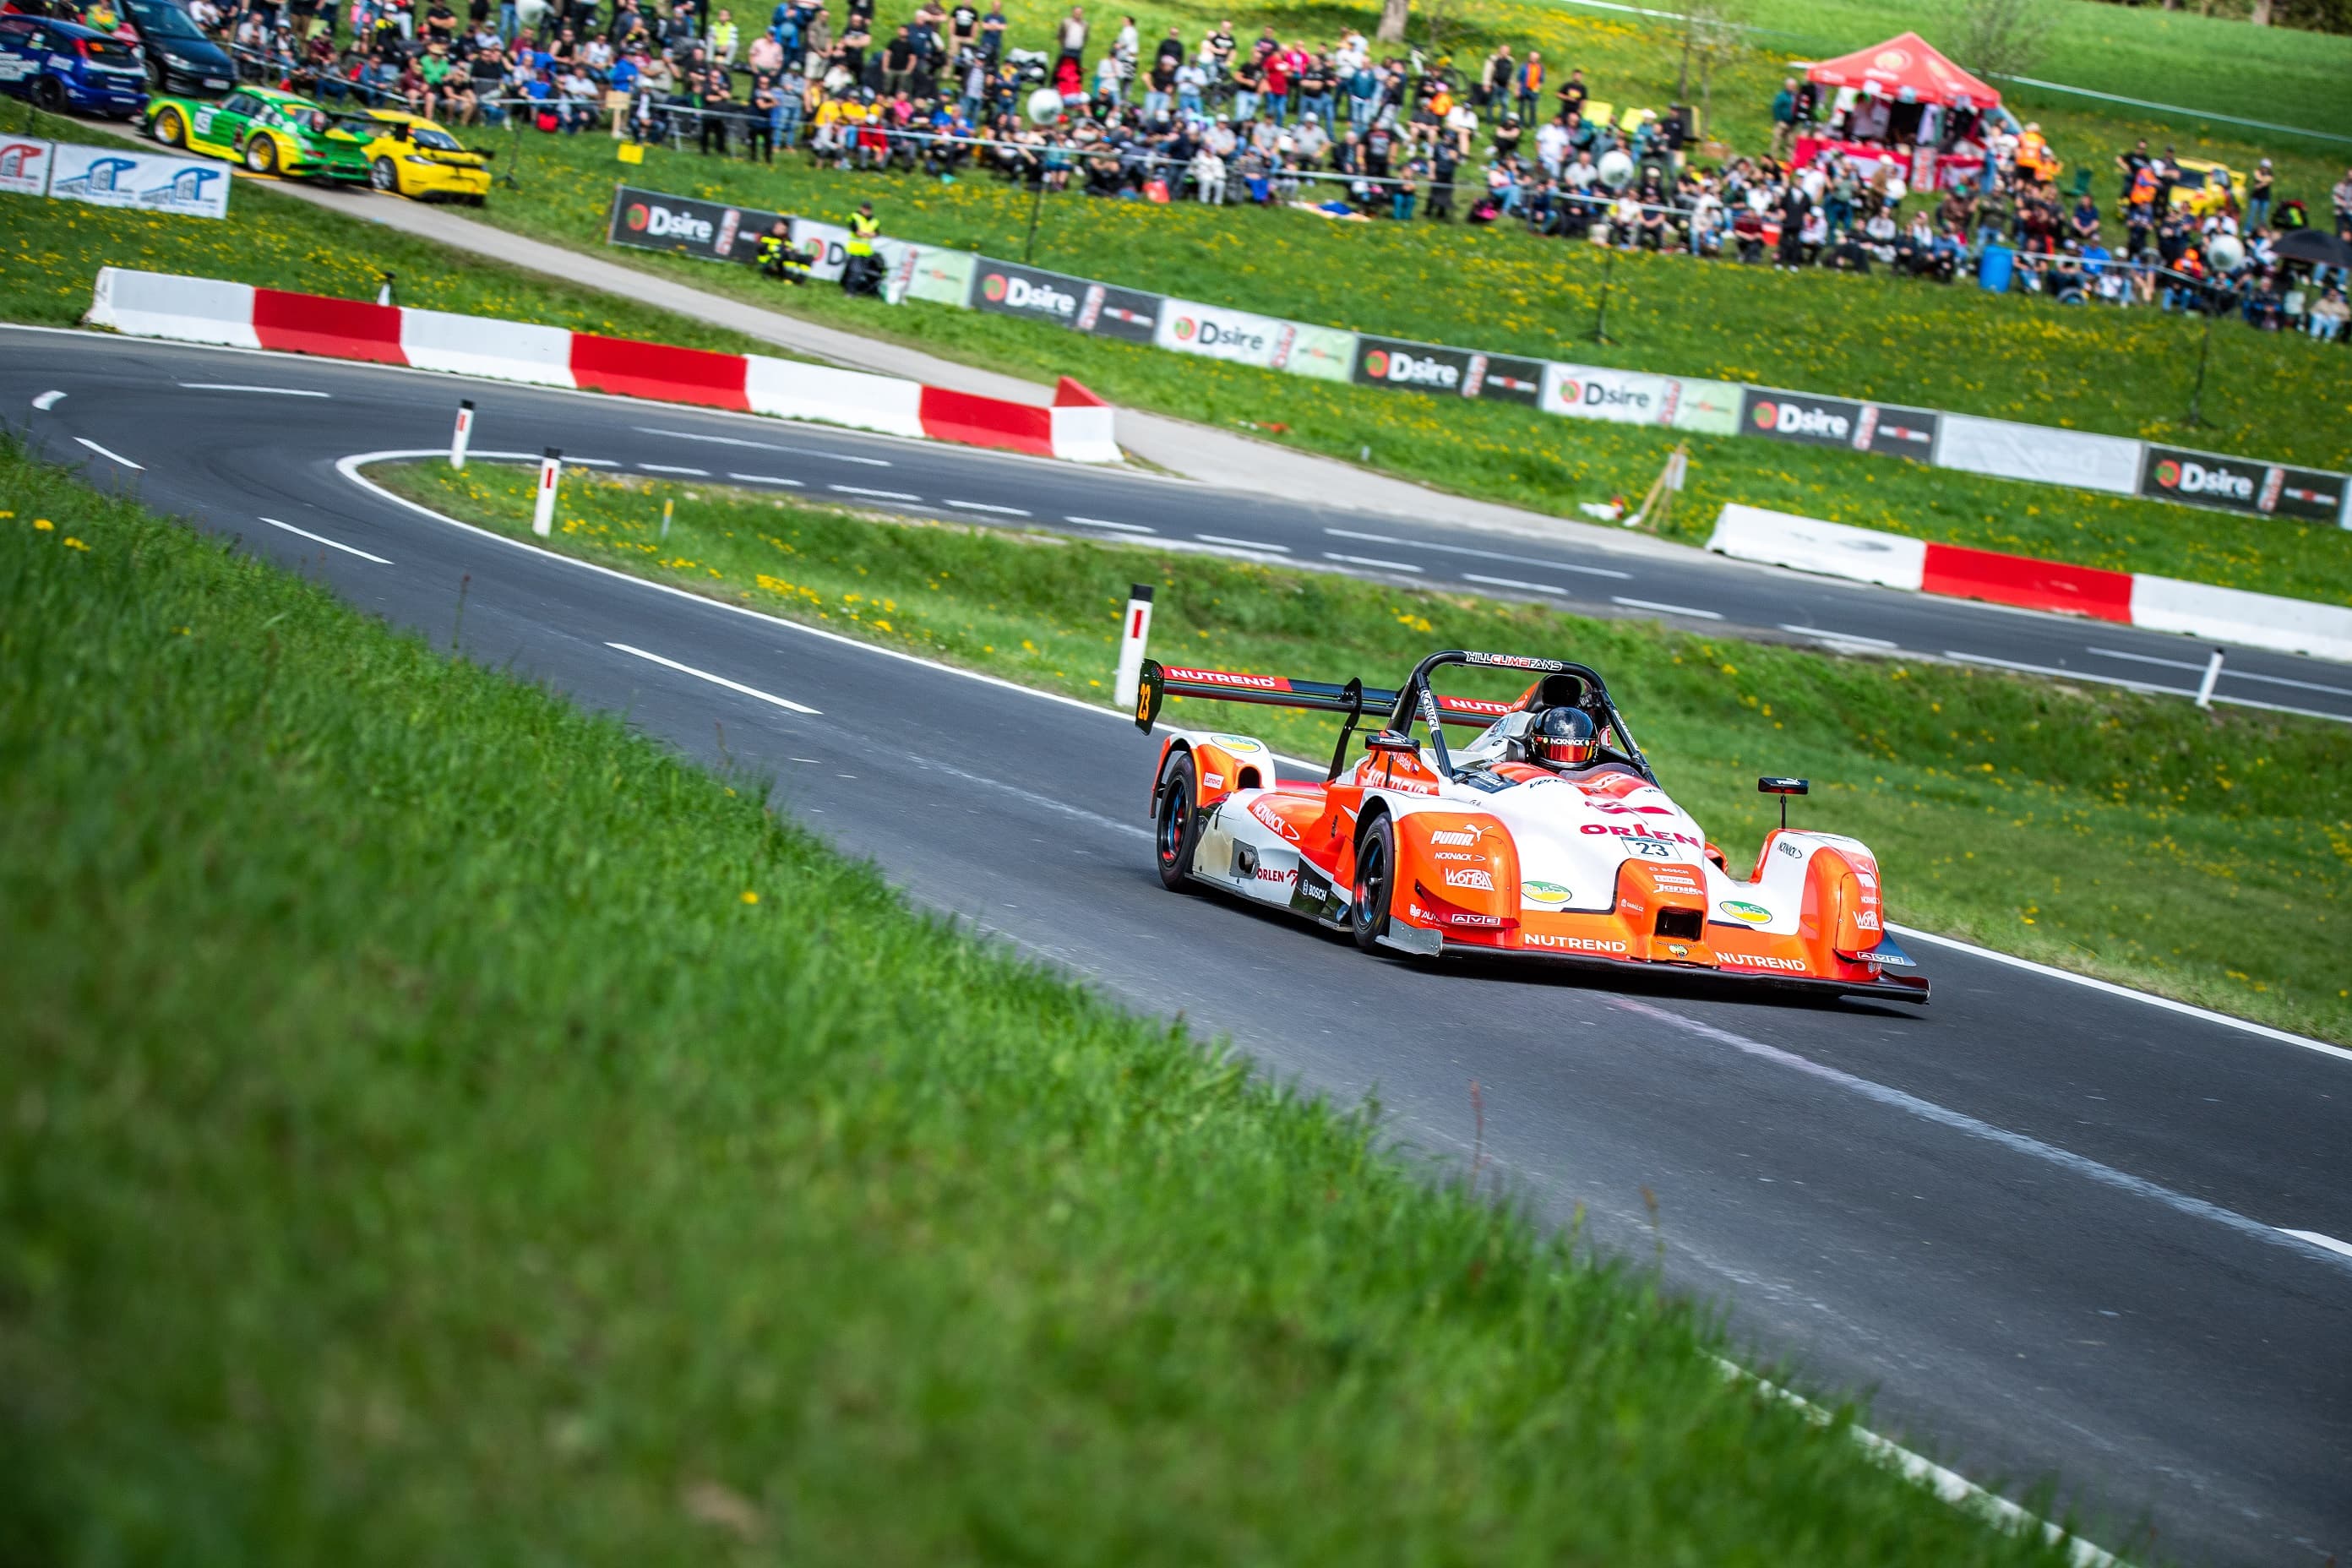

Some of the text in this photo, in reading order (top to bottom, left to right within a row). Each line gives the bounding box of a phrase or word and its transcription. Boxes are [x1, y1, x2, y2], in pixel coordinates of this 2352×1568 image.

[647, 206, 713, 238] Dsire
[1004, 277, 1076, 313] Dsire
[1199, 320, 1263, 350] Dsire
[1387, 351, 1459, 384] Dsire
[1585, 383, 1649, 407] Dsire
[1777, 403, 1849, 435] Dsire
[2179, 462, 2253, 495] Dsire
[1467, 651, 1563, 671] HILLCLIMBFANS
[1171, 668, 1275, 688] NUTREND
[1138, 683, 1150, 721] 23
[1449, 699, 1514, 713] NUTR
[1205, 776, 1221, 786] Lenovo
[1430, 830, 1474, 846] PUMA
[1581, 824, 1701, 850] ORLEN
[1435, 852, 1472, 861] NCKNACK
[1636, 842, 1669, 857] 23
[1257, 868, 1285, 883] ORLEN
[1309, 884, 1327, 902] BOSCH
[1452, 914, 1500, 925] AVE
[1524, 933, 1626, 952] NUTREND
[1715, 951, 1805, 972] NUTREND
